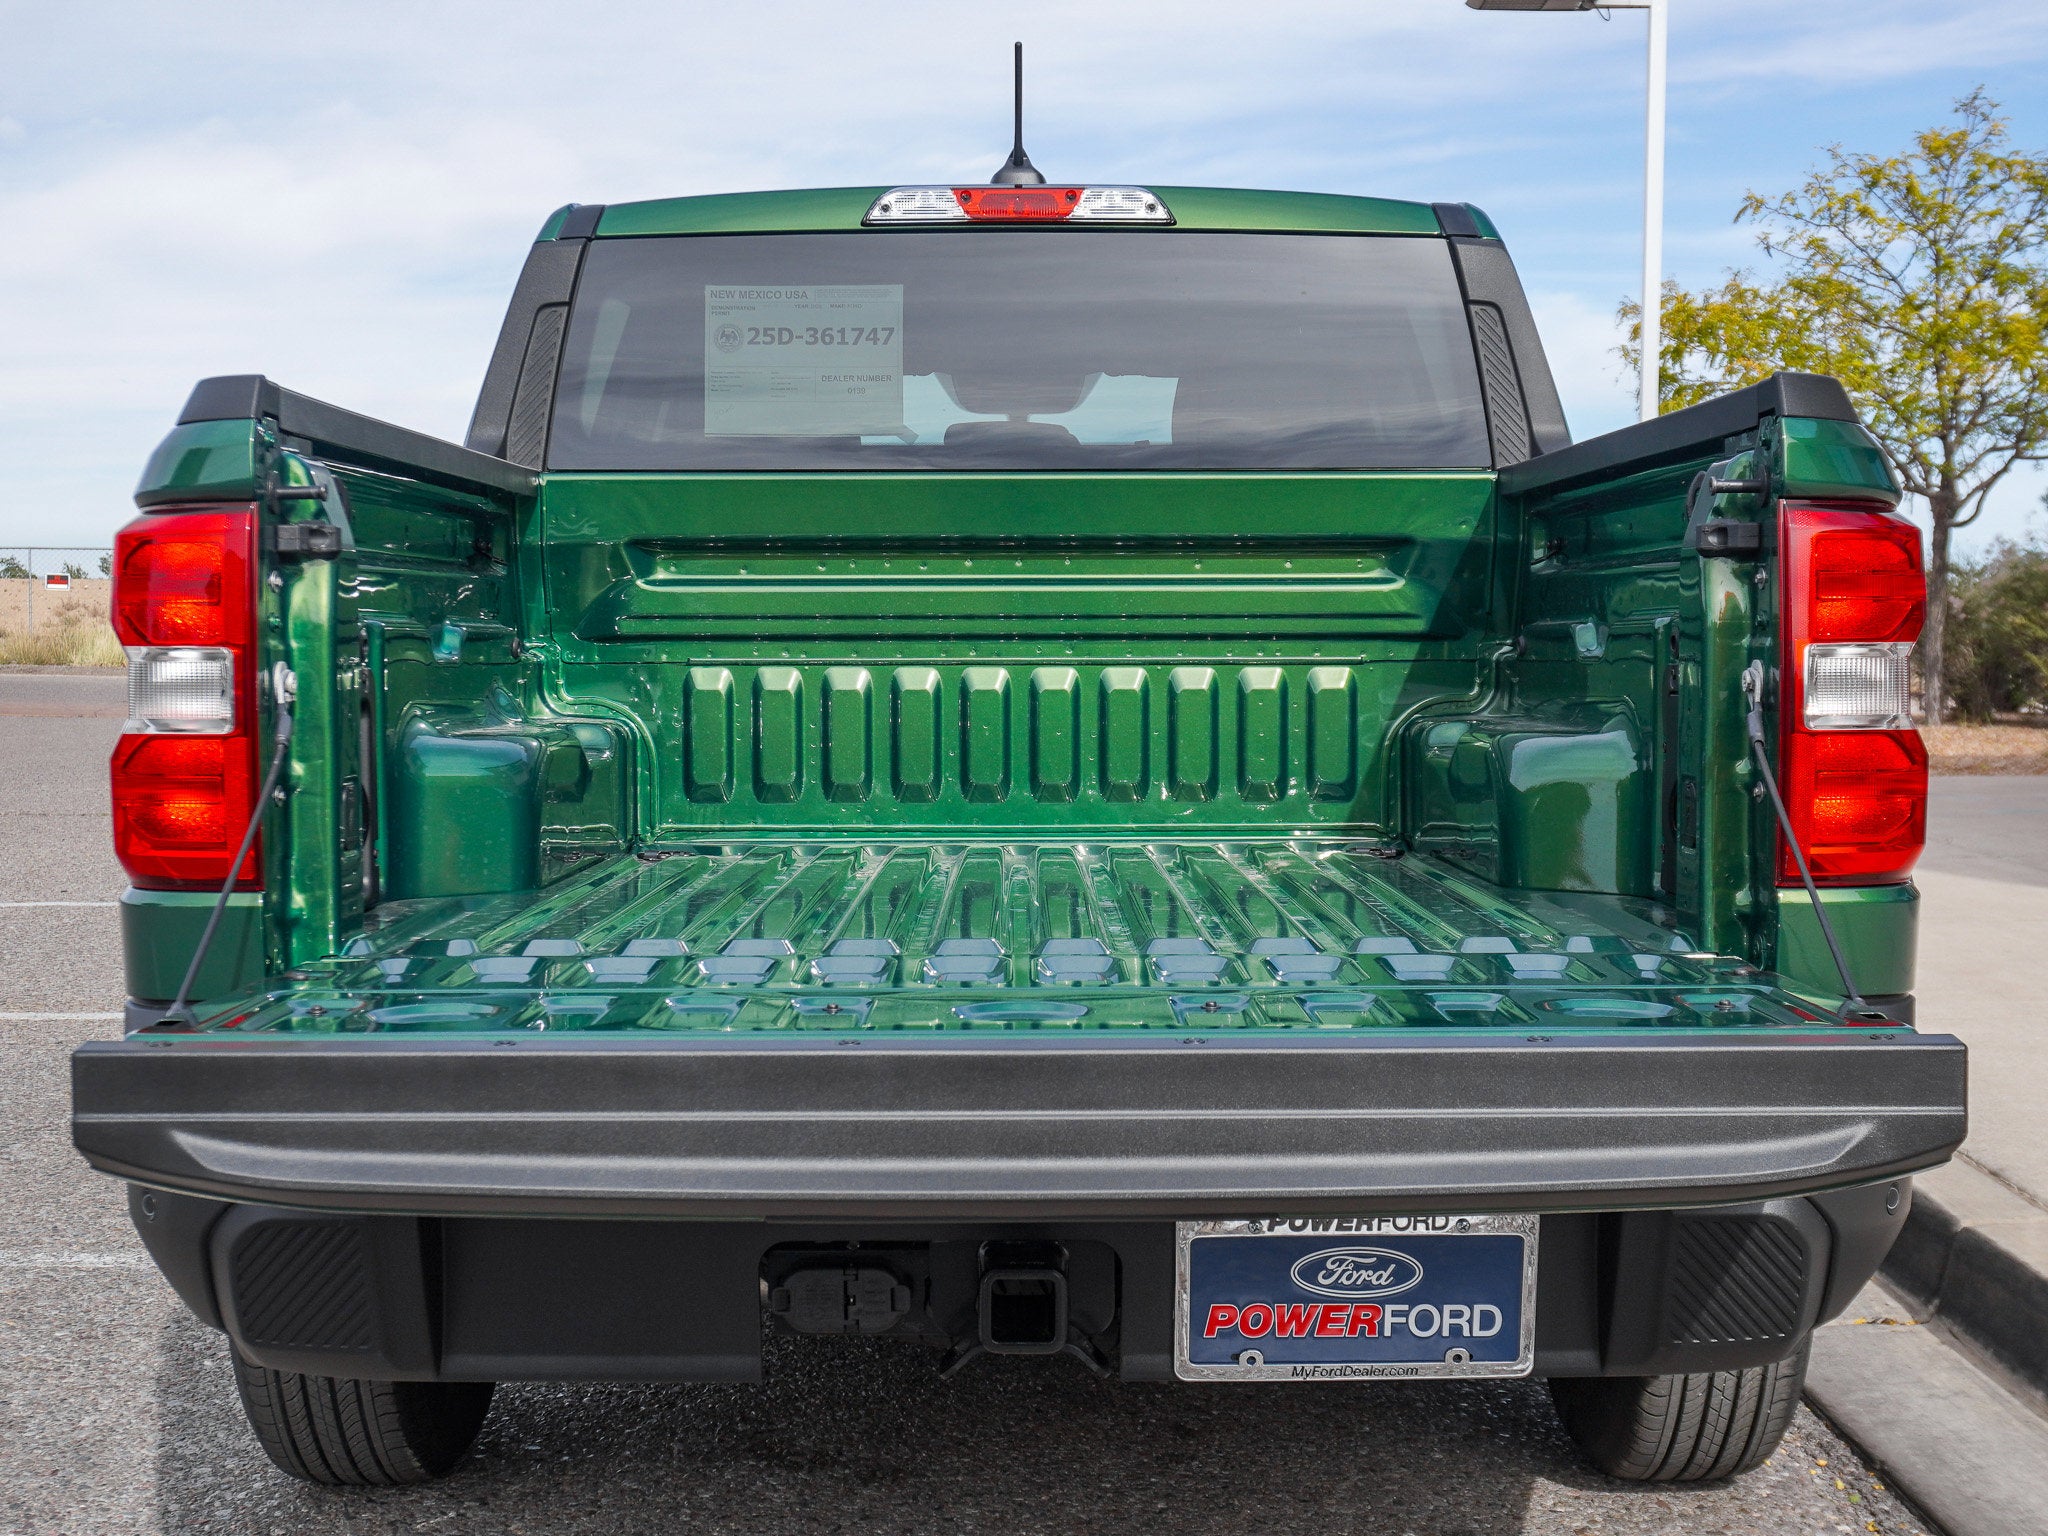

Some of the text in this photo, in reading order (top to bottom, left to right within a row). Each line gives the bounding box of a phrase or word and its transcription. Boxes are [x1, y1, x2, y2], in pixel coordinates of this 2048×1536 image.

[710, 290, 735, 299] NEW
[738, 290, 782, 300] MEXICO
[785, 290, 809, 300] USA
[747, 327, 895, 346] 25D-361747
[1267, 1216, 1450, 1232] POWERFORD
[1316, 1255, 1396, 1287] Ford
[1203, 1303, 1504, 1338] POWERFORD
[1291, 1365, 1419, 1380] MyFordDealer.com
